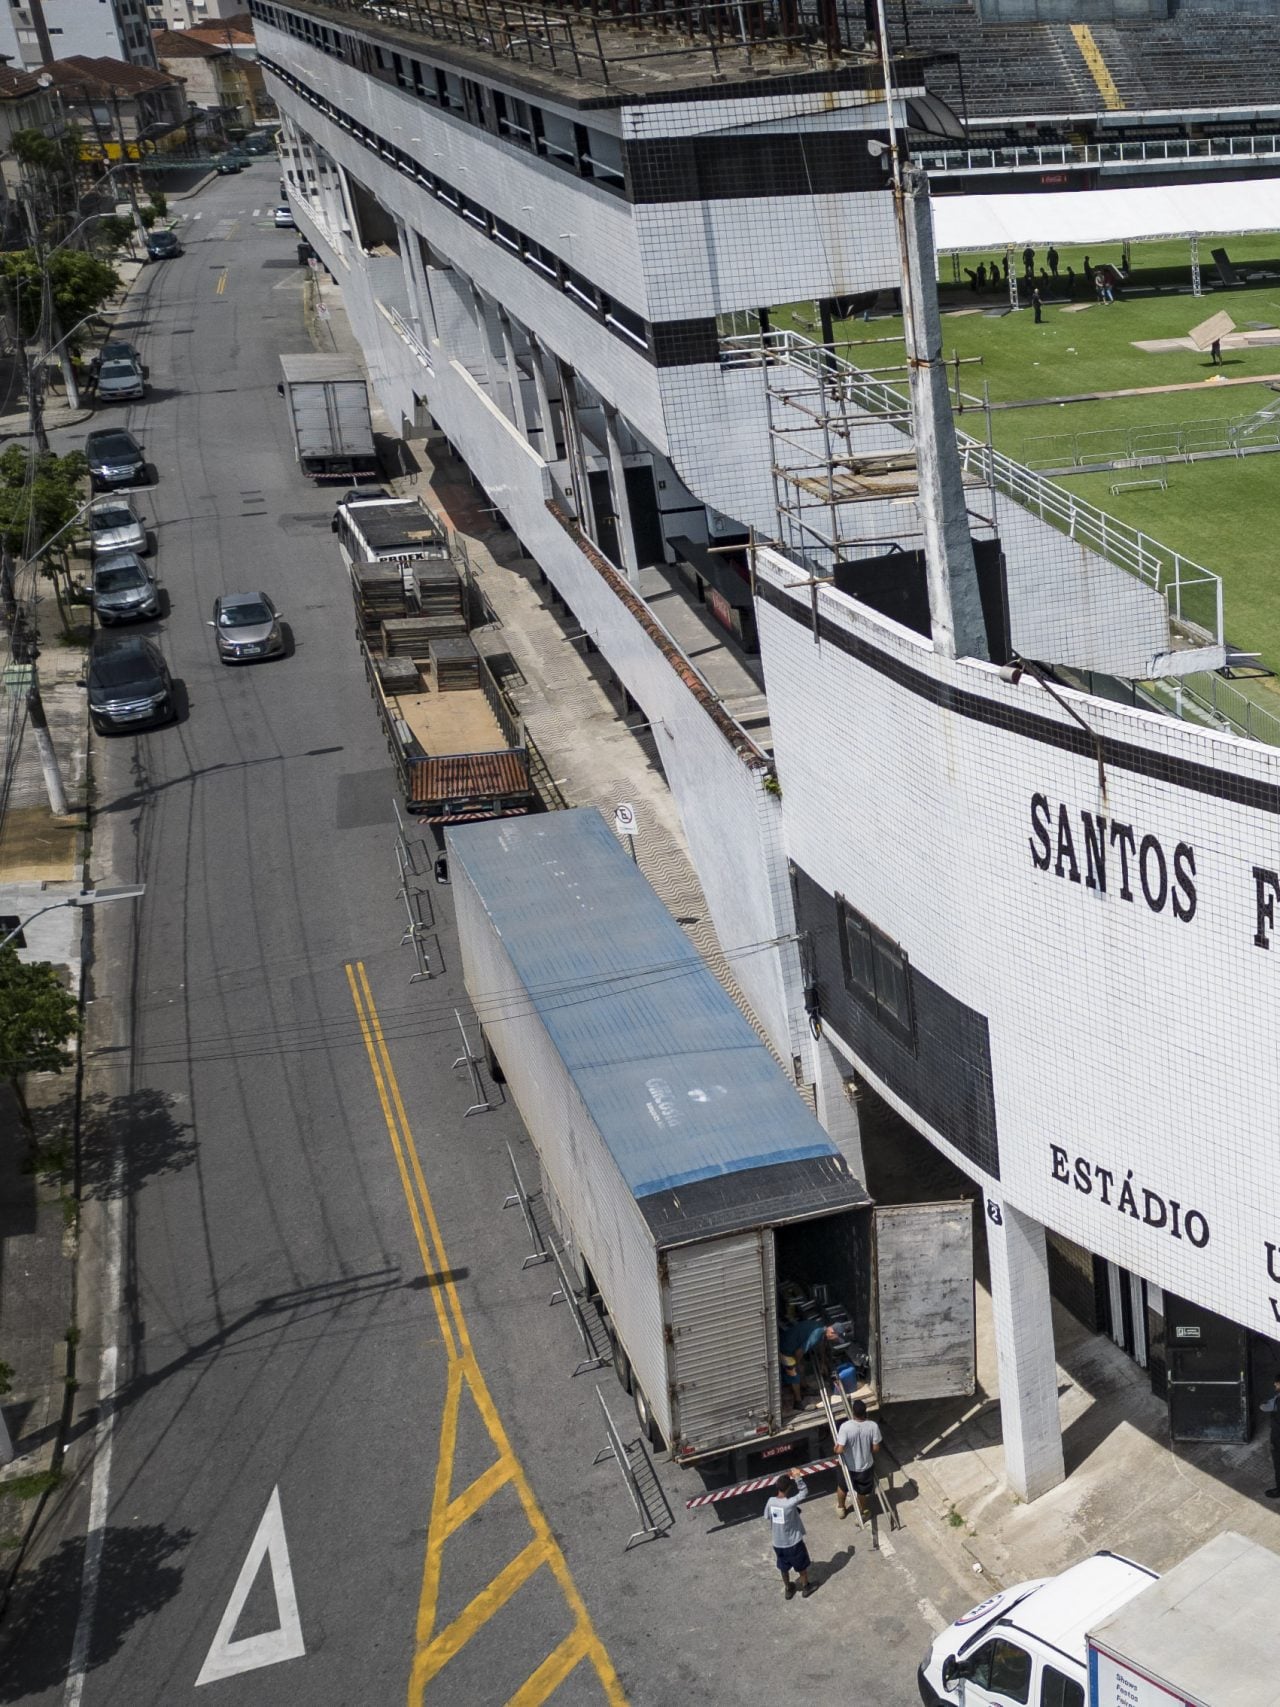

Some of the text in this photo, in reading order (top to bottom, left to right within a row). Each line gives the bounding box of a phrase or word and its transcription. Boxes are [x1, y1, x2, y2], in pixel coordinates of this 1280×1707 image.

[1028, 792, 1197, 923] SANTOS
[991, 1206, 999, 1221] 2
[1050, 1143, 1210, 1248] ESTÁDIO
[1116, 1673, 1137, 1691] Shows
